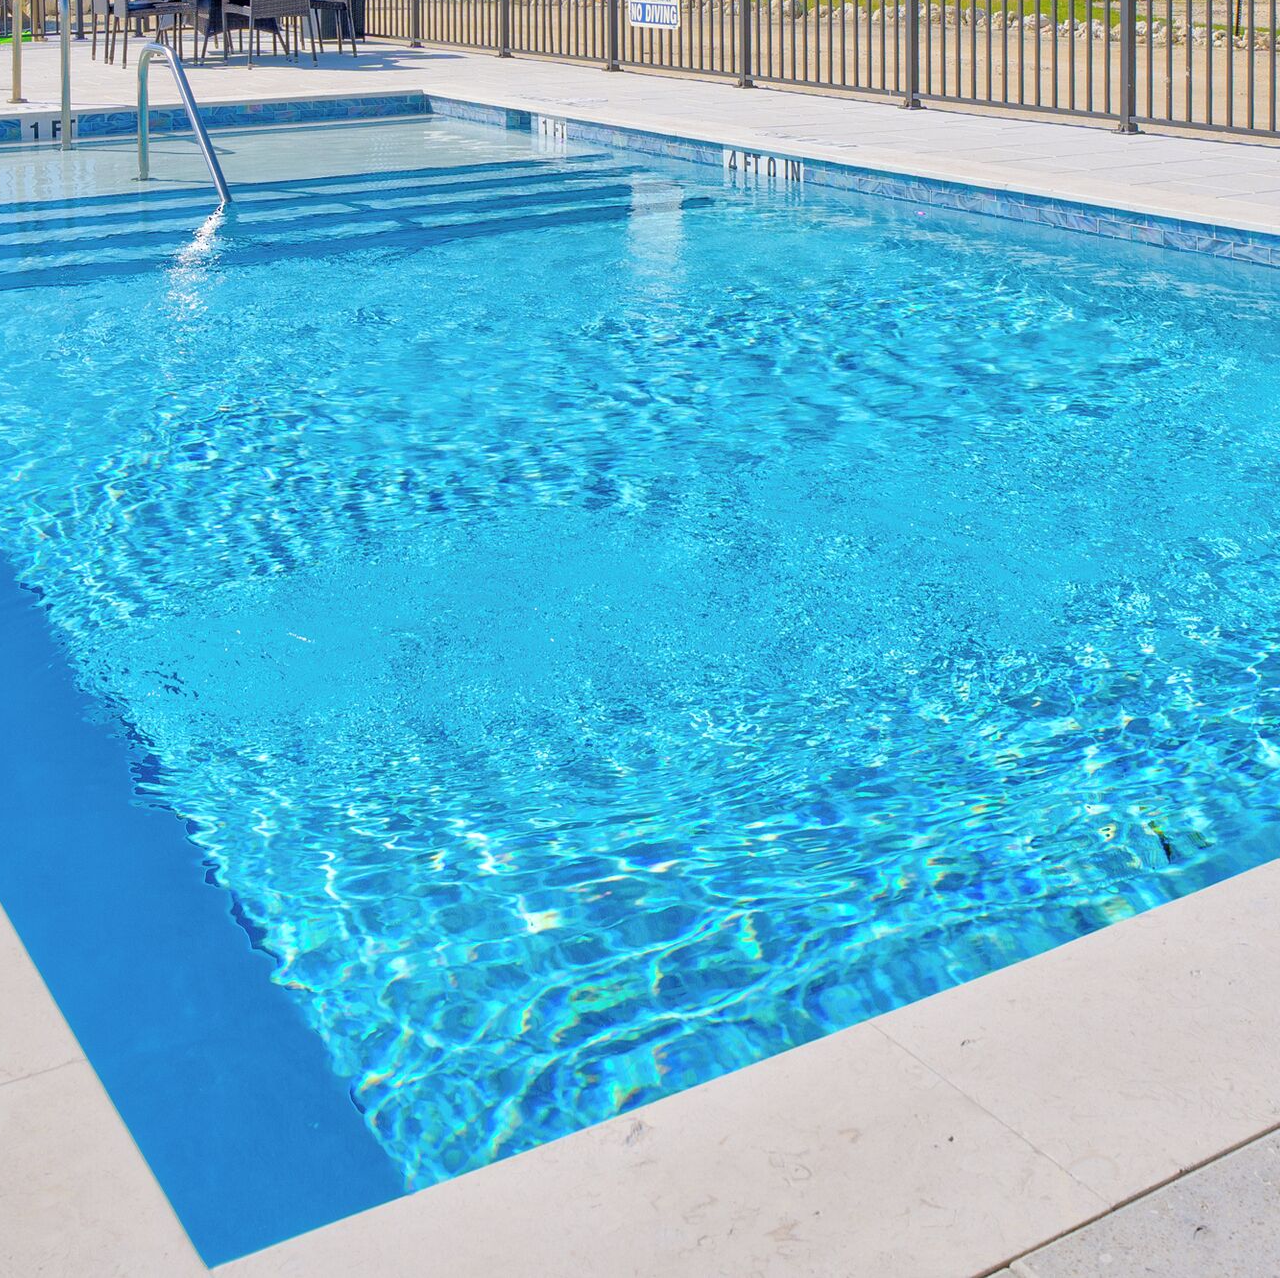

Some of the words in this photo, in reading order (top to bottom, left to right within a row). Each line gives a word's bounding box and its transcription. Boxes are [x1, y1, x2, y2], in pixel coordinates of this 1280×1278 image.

[631, 3, 643, 21] NO
[646, 3, 677, 24] DIVING
[30, 122, 39, 139] 1
[541, 118, 548, 136] 1
[552, 122, 566, 140] FT
[728, 150, 738, 171] 4
[743, 152, 761, 175] FT
[785, 158, 800, 182] IN
